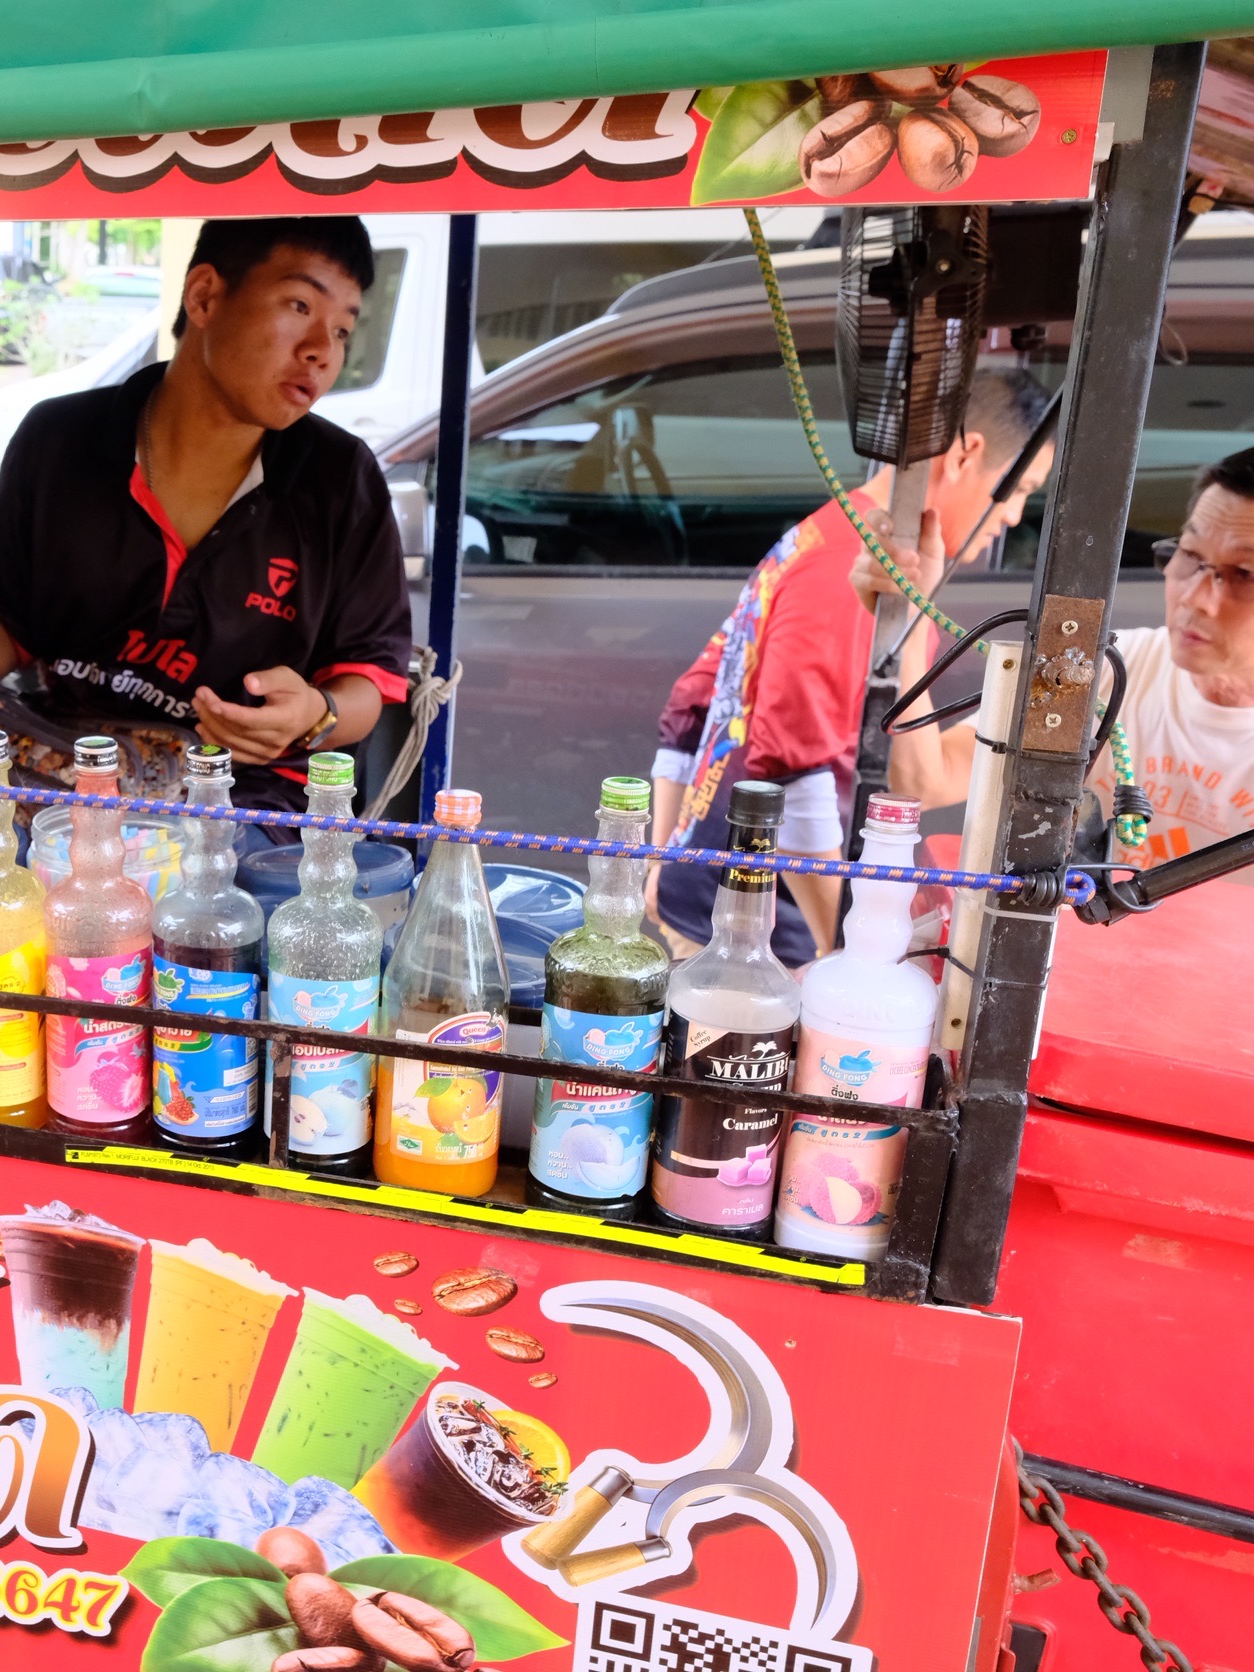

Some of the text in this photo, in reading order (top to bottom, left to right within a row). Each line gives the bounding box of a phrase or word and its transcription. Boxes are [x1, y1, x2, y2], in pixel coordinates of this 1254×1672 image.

[245, 592, 296, 621] POLO
[295, 1005, 337, 1017] DING FONG
[689, 1029, 707, 1043] Coffee
[693, 1034, 712, 1048] Syrup
[586, 1044, 631, 1056] DING FONG
[821, 1064, 868, 1083] DING FONG
[722, 1113, 779, 1132] Caramel
[722, 1203, 764, 1216] คาราเมล
